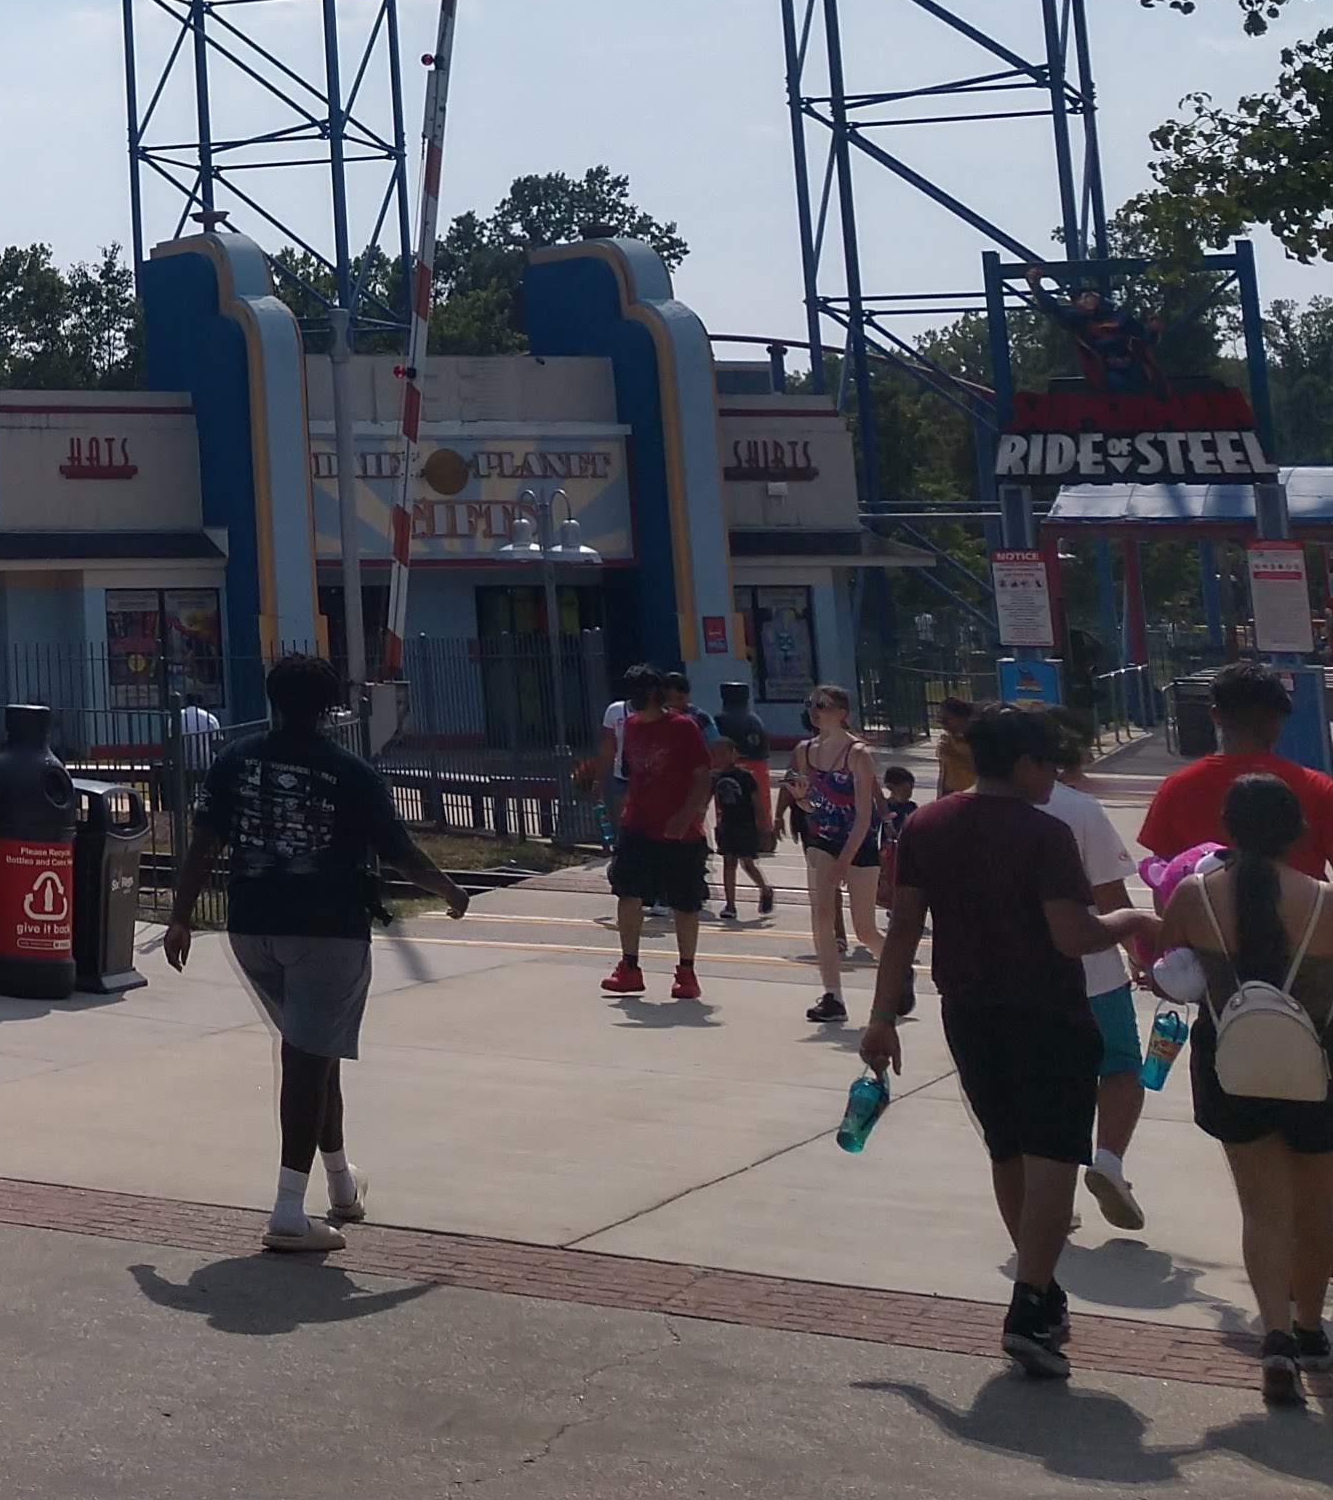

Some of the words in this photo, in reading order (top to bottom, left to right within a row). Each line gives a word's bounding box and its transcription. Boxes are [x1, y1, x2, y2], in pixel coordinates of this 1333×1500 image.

[66, 436, 130, 468] HATS
[733, 440, 812, 468] SHIRTS
[995, 432, 1105, 475] RIDE
[1107, 438, 1132, 456] OF
[1135, 430, 1280, 475] STEEL
[473, 452, 612, 479] PLANET
[996, 552, 1040, 561] NOTICE
[5, 854, 34, 866] Bottles
[35, 857, 50, 867] and
[20, 846, 48, 857] Please
[16, 922, 41, 935] give
[43, 923, 51, 935] it
